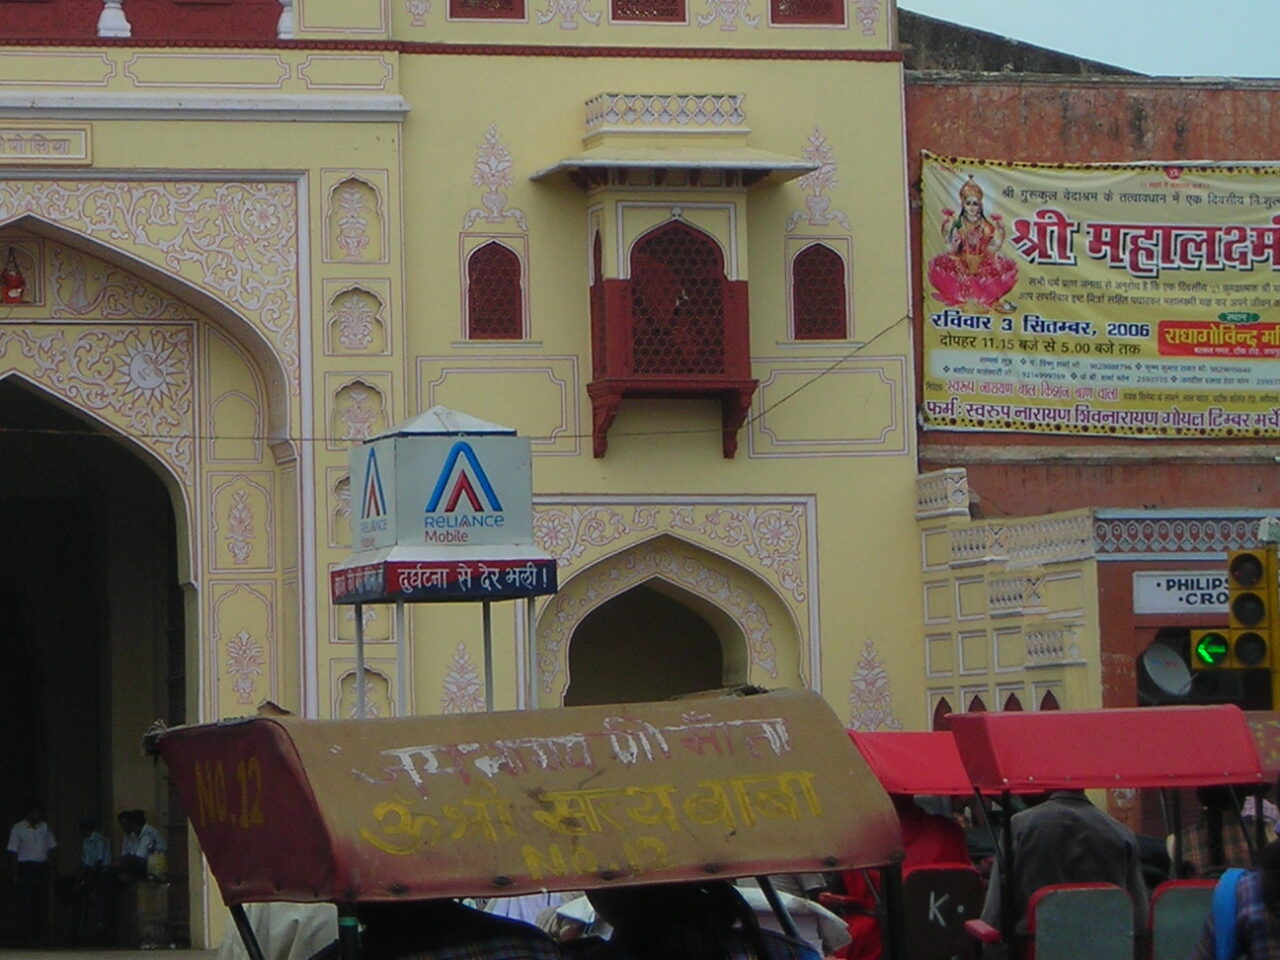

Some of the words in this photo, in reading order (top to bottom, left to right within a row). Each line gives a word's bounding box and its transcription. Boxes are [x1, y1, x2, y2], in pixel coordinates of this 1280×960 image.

[1011, 209, 1076, 262] श्री
[932, 309, 991, 330] रविवार
[1001, 318, 1012, 330] 3
[1108, 323, 1150, 337] 2006
[940, 332, 976, 347] दोपहर
[982, 337, 1014, 350] 11.15
[1018, 338, 1039, 351] बजे
[1044, 337, 1055, 352] से
[1061, 343, 1090, 353] 5.00
[1095, 340, 1114, 353] बजे
[1119, 343, 1141, 355] तक
[1014, 406, 1071, 422] नारायण
[1076, 404, 1158, 424] शिवनारायण
[1162, 408, 1204, 426] गोयल
[424, 530, 469, 543] Mobile
[398, 564, 450, 593] दुर्घटना
[457, 563, 473, 591] से
[478, 563, 502, 591] देर
[1186, 592, 1228, 605] CRO
